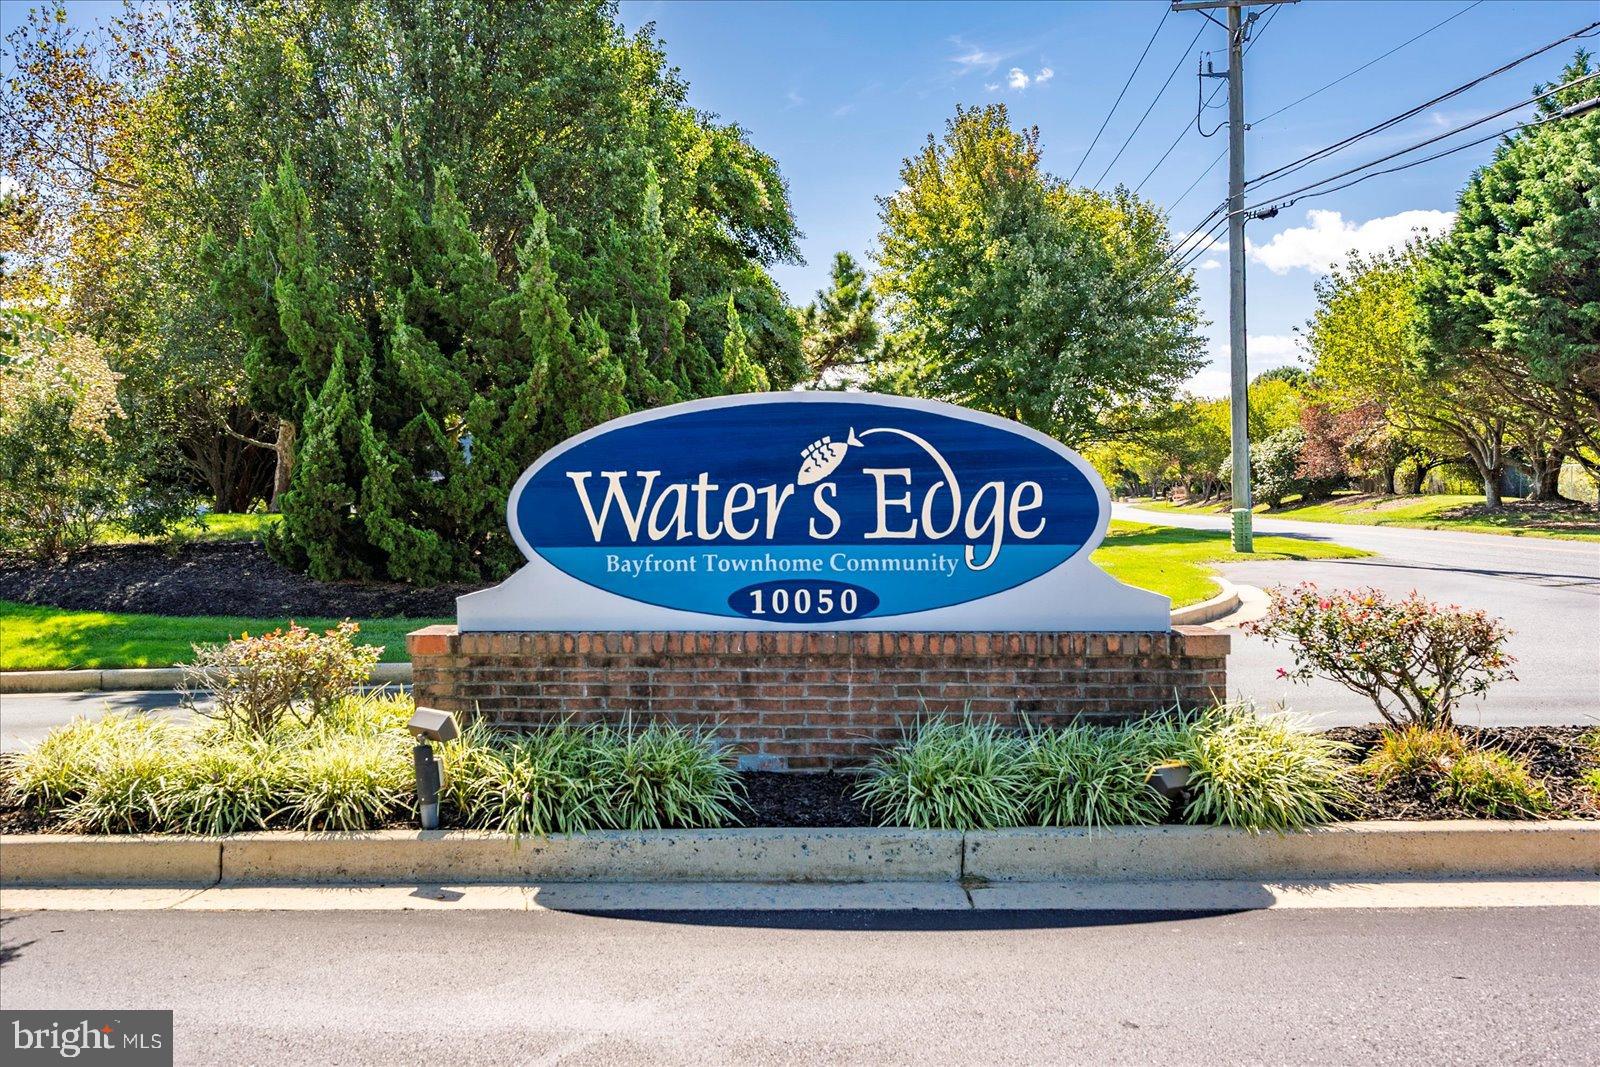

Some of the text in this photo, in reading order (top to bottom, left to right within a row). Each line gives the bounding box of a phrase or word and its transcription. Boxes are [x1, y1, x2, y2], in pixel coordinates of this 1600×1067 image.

[565, 428, 1047, 572] Water's Edge
[605, 553, 960, 577] Bayfront Townhome Community
[749, 589, 858, 614] 10050
